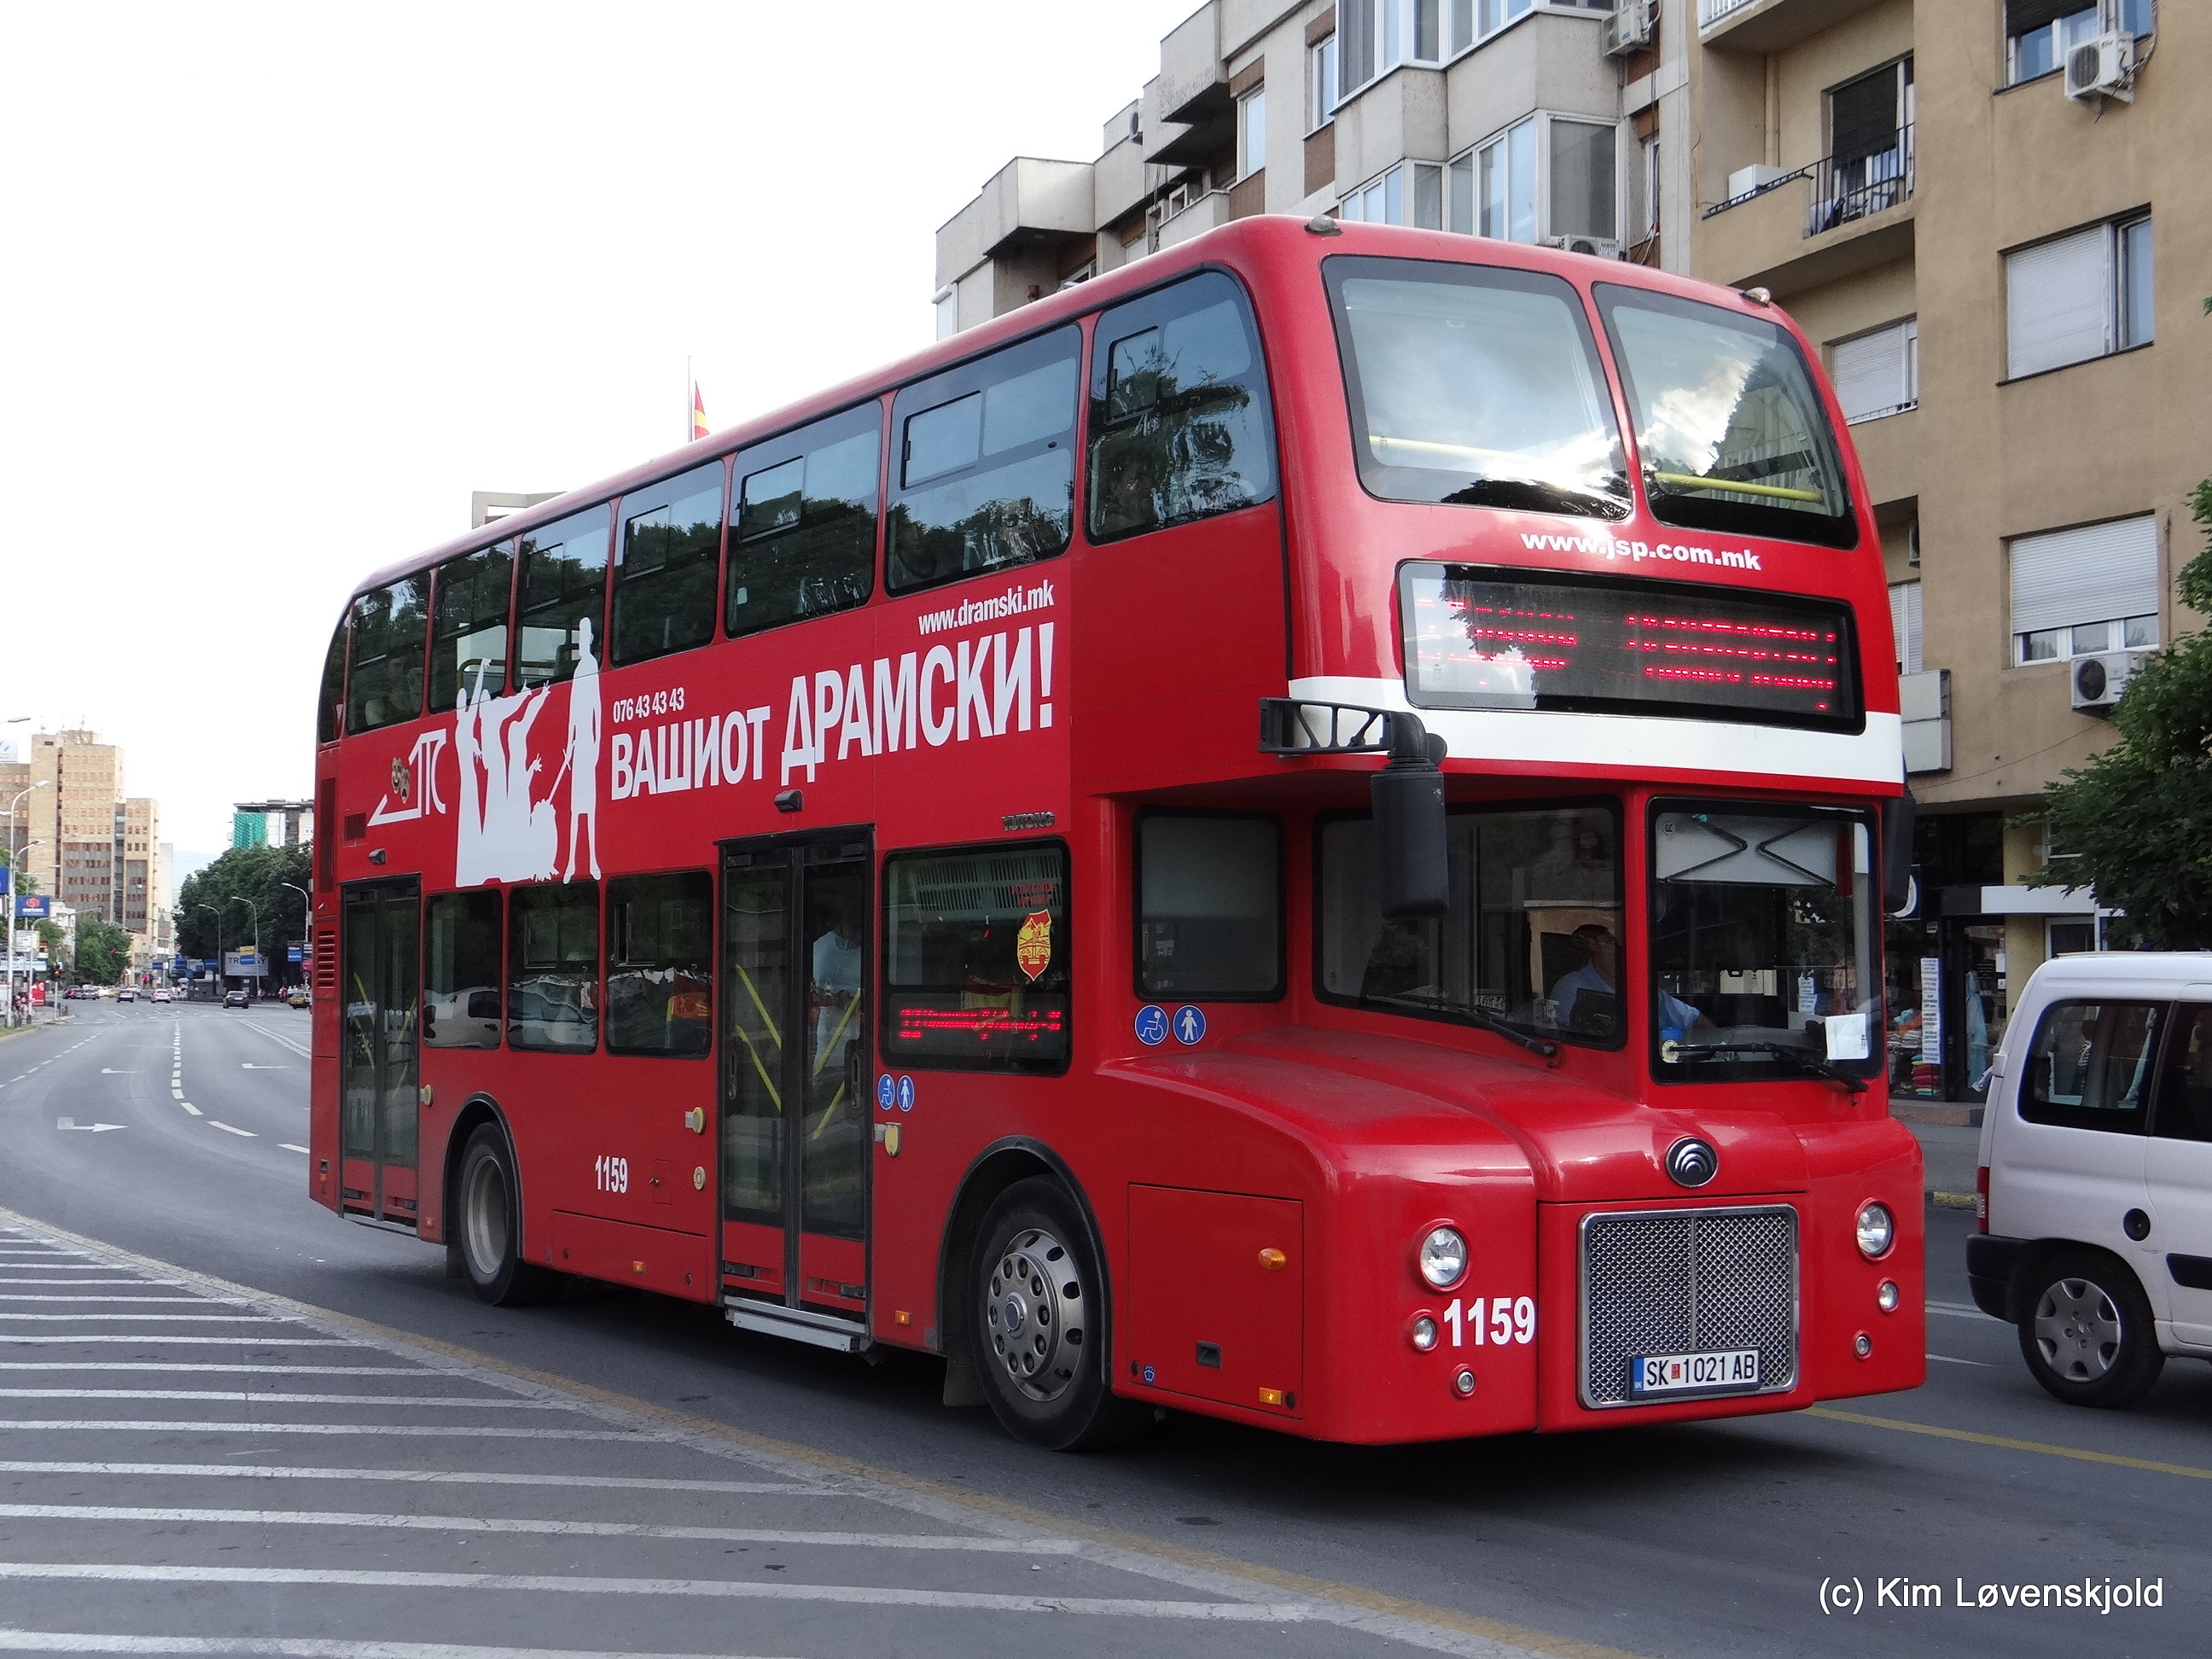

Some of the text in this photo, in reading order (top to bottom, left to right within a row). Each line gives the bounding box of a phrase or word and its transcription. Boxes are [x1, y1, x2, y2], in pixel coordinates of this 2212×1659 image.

[1520, 530, 1762, 571] www.jsp.com.mk
[918, 579, 1055, 635] www.dramski.mk
[611, 622, 1054, 800] ВАШИОТ ДРАМСКИ!
[613, 687, 684, 724] 076 43 43 43
[1001, 812, 1056, 832] YUTONG
[595, 1155, 628, 1194] 1159
[1444, 1296, 1535, 1347] 1159
[1646, 1359, 1669, 1386] SK
[1683, 1356, 1726, 1383] 1021
[1732, 1354, 1755, 1380] AB
